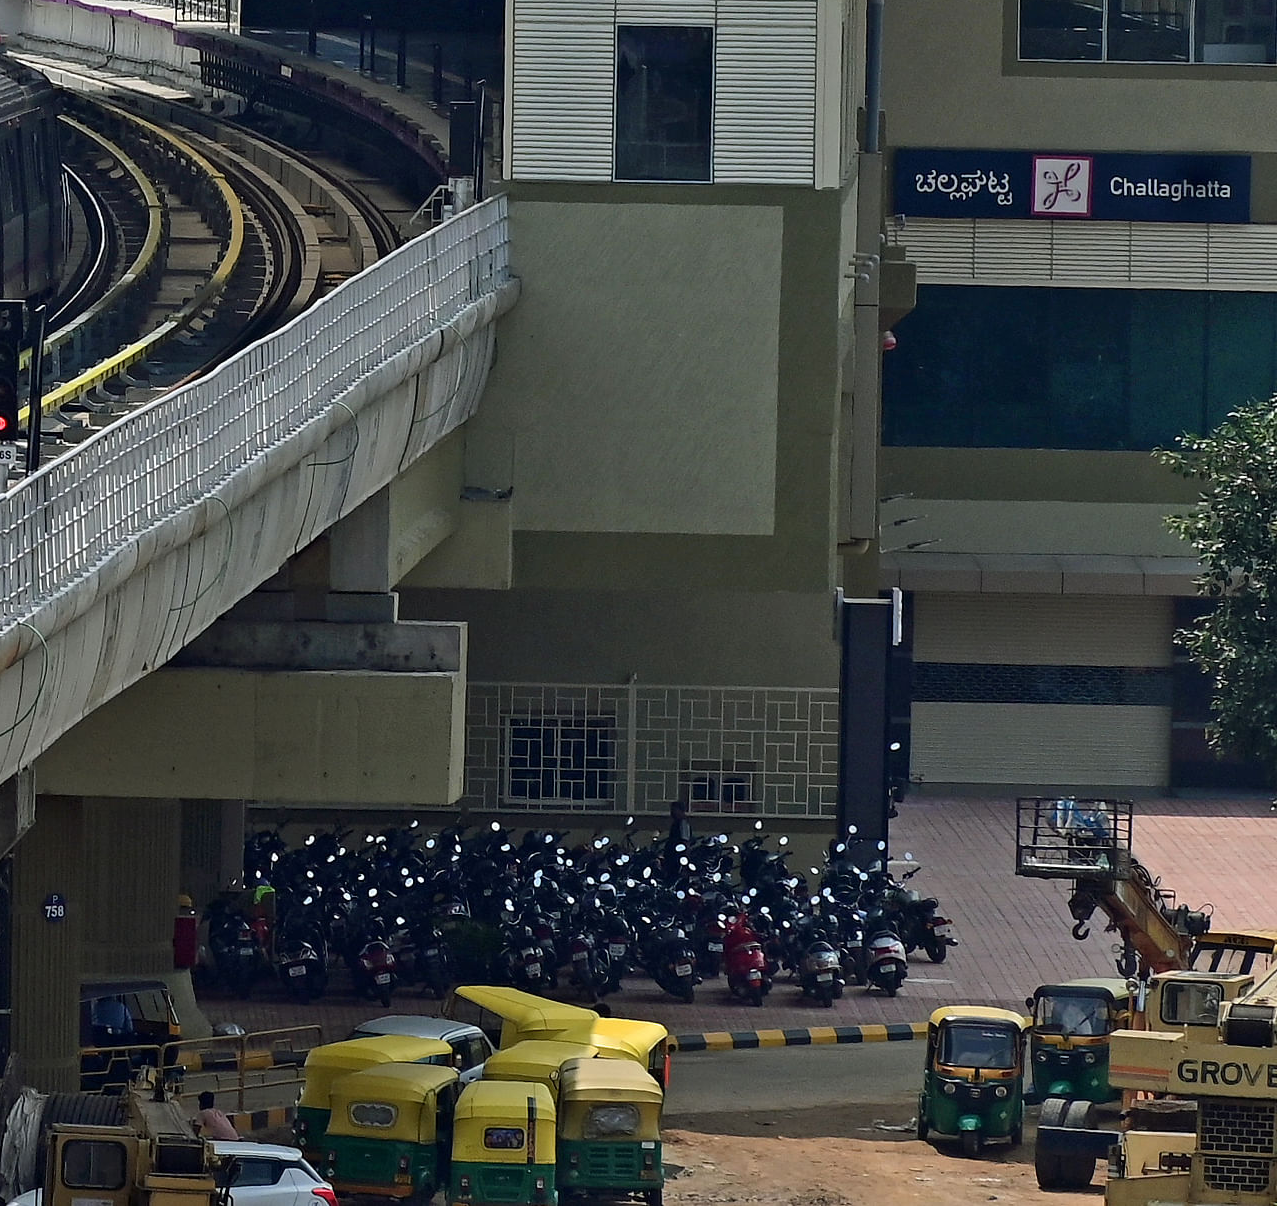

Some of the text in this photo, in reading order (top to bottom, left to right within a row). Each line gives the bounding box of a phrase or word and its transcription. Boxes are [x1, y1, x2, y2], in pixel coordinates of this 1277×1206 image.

[915, 169, 1013, 205] ಚಲ್ಲಘಟ್ಟ
[1110, 176, 1232, 202] Challaghatta
[44, 905, 65, 918] 758
[52, 894, 59, 904] P
[1177, 1059, 1277, 1088] GROVE
